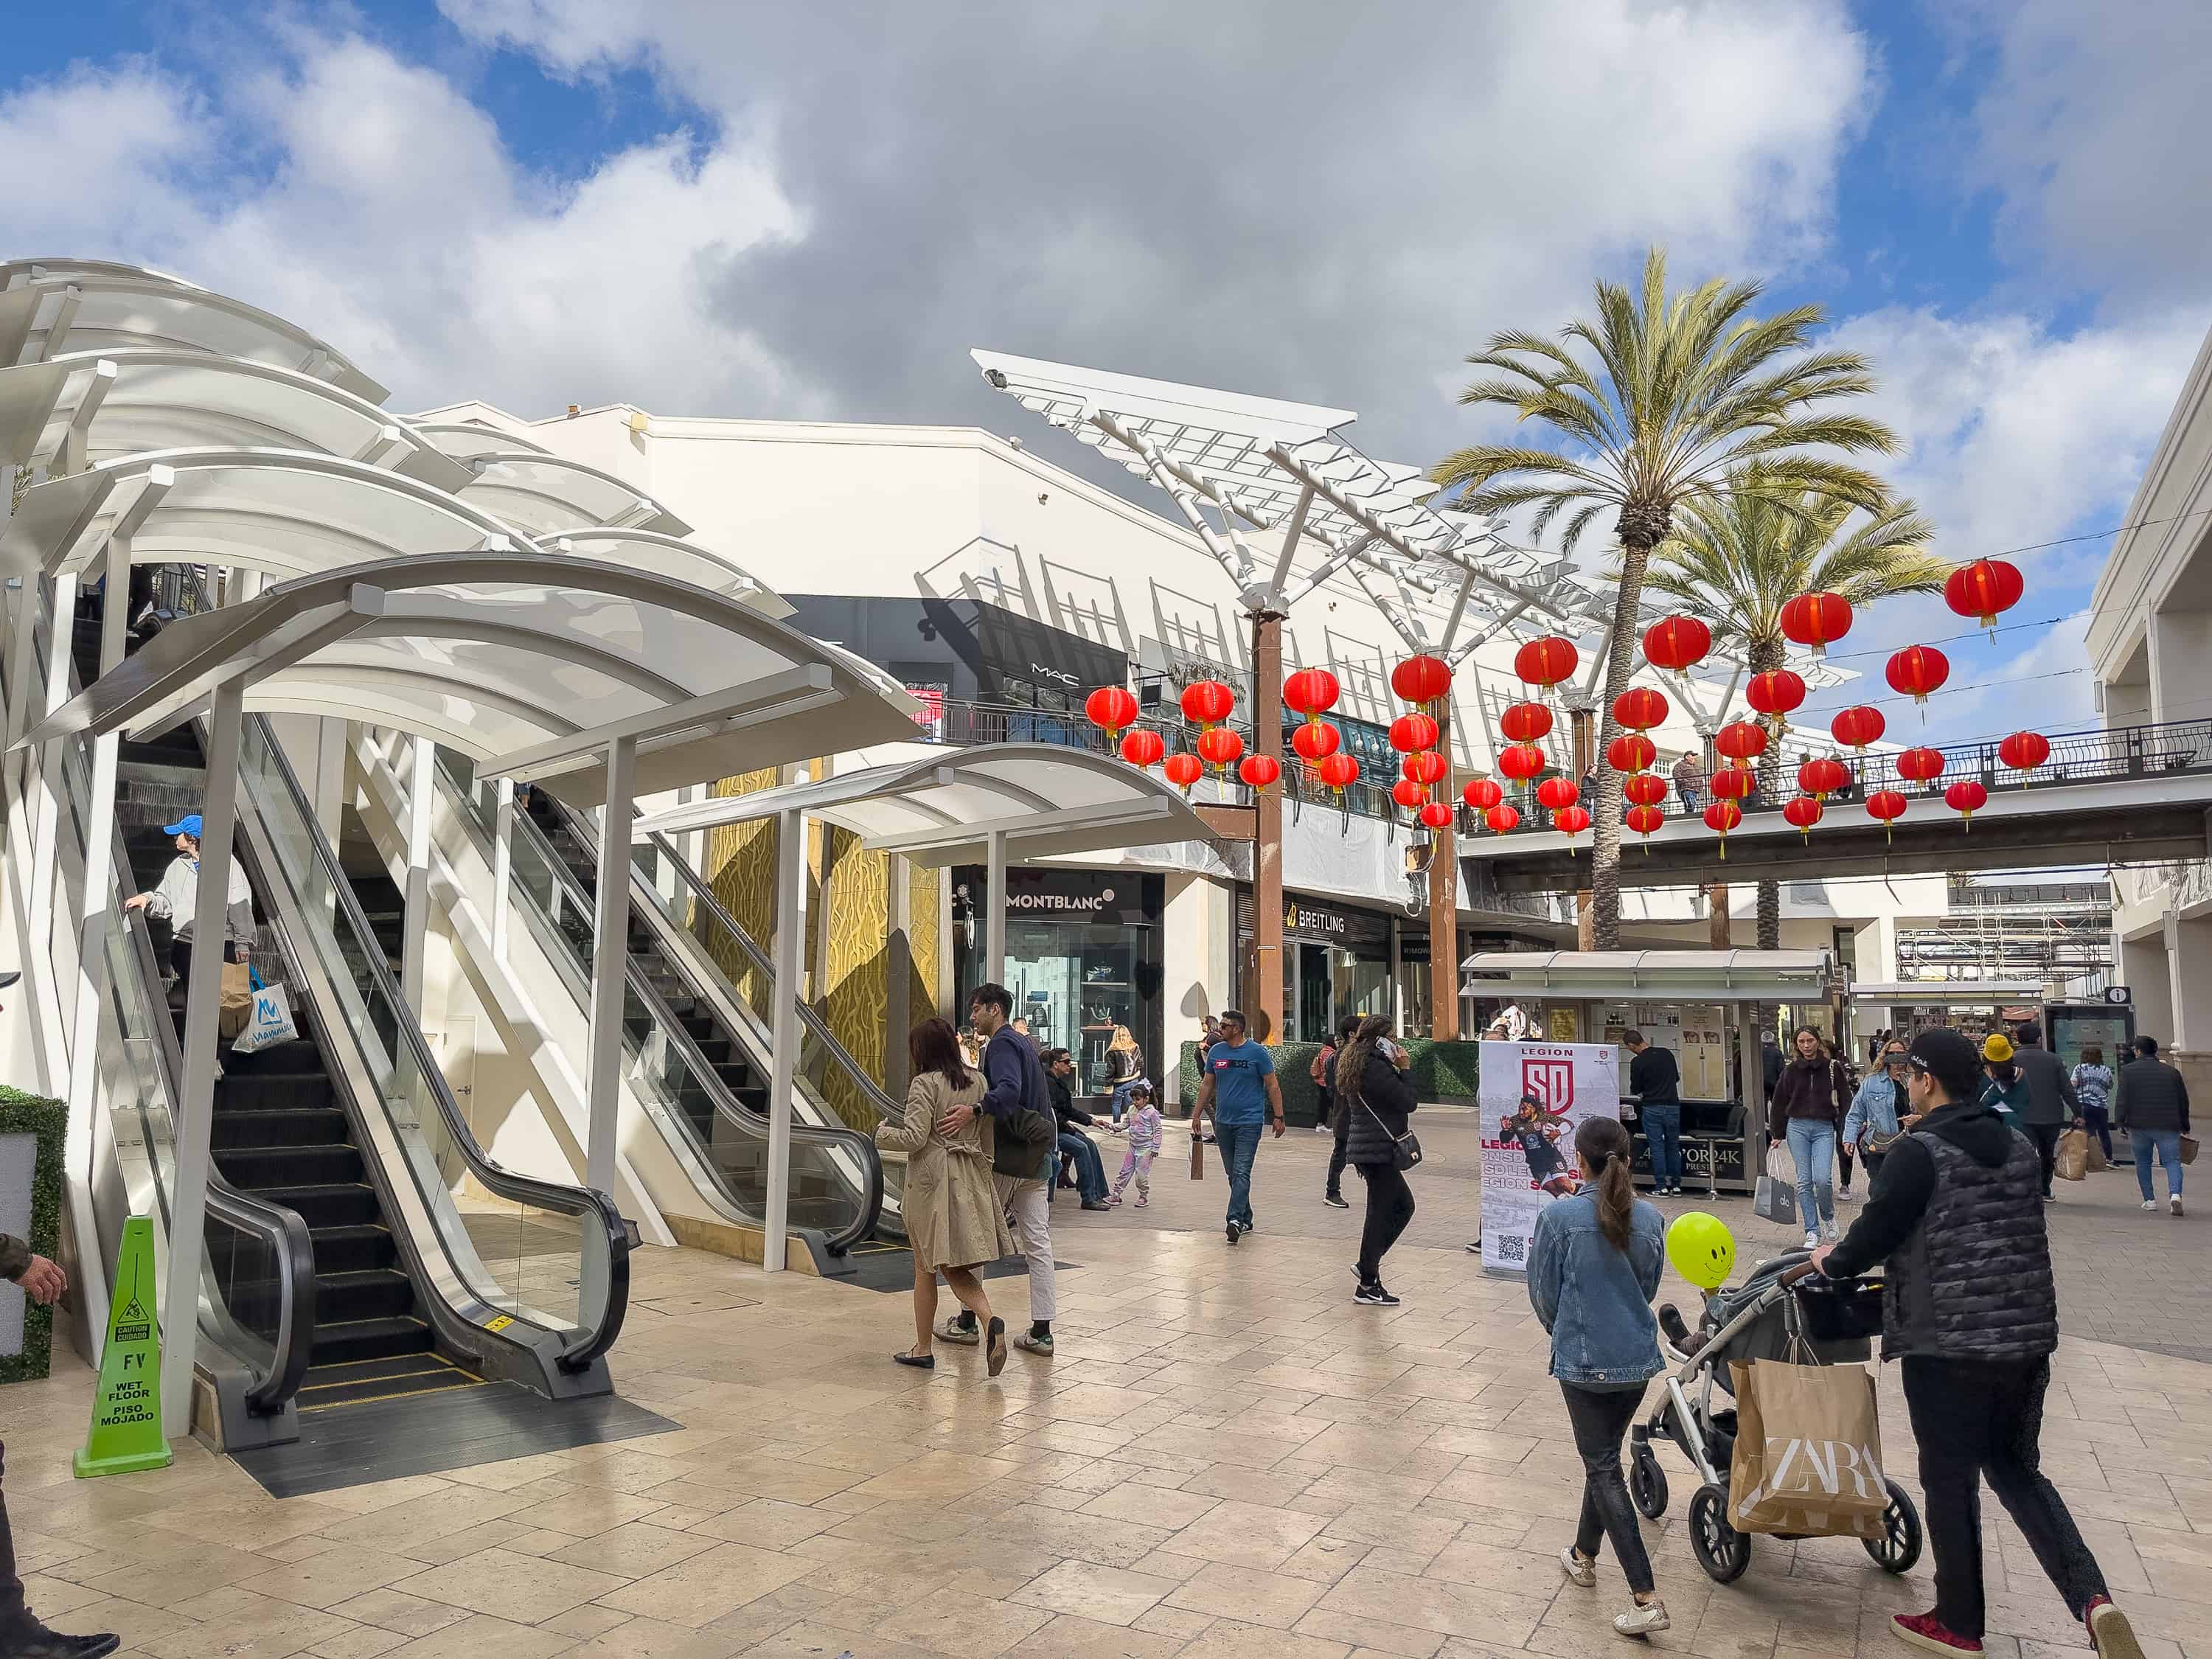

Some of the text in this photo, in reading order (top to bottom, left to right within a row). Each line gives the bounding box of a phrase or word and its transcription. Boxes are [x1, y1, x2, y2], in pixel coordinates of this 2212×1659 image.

[1006, 894, 1103, 910] MONTBLANC
[1299, 910, 1345, 933] BREITLING
[1521, 1048, 1573, 1057] LEGION
[118, 1324, 148, 1334] CAUTION
[118, 1332, 147, 1341] CUIDADO
[116, 1380, 143, 1391] WET
[108, 1389, 150, 1402] FLOOR
[114, 1404, 143, 1416] PISO
[101, 1412, 154, 1427] MOJADO
[1765, 1436, 1888, 1500] ZARA
